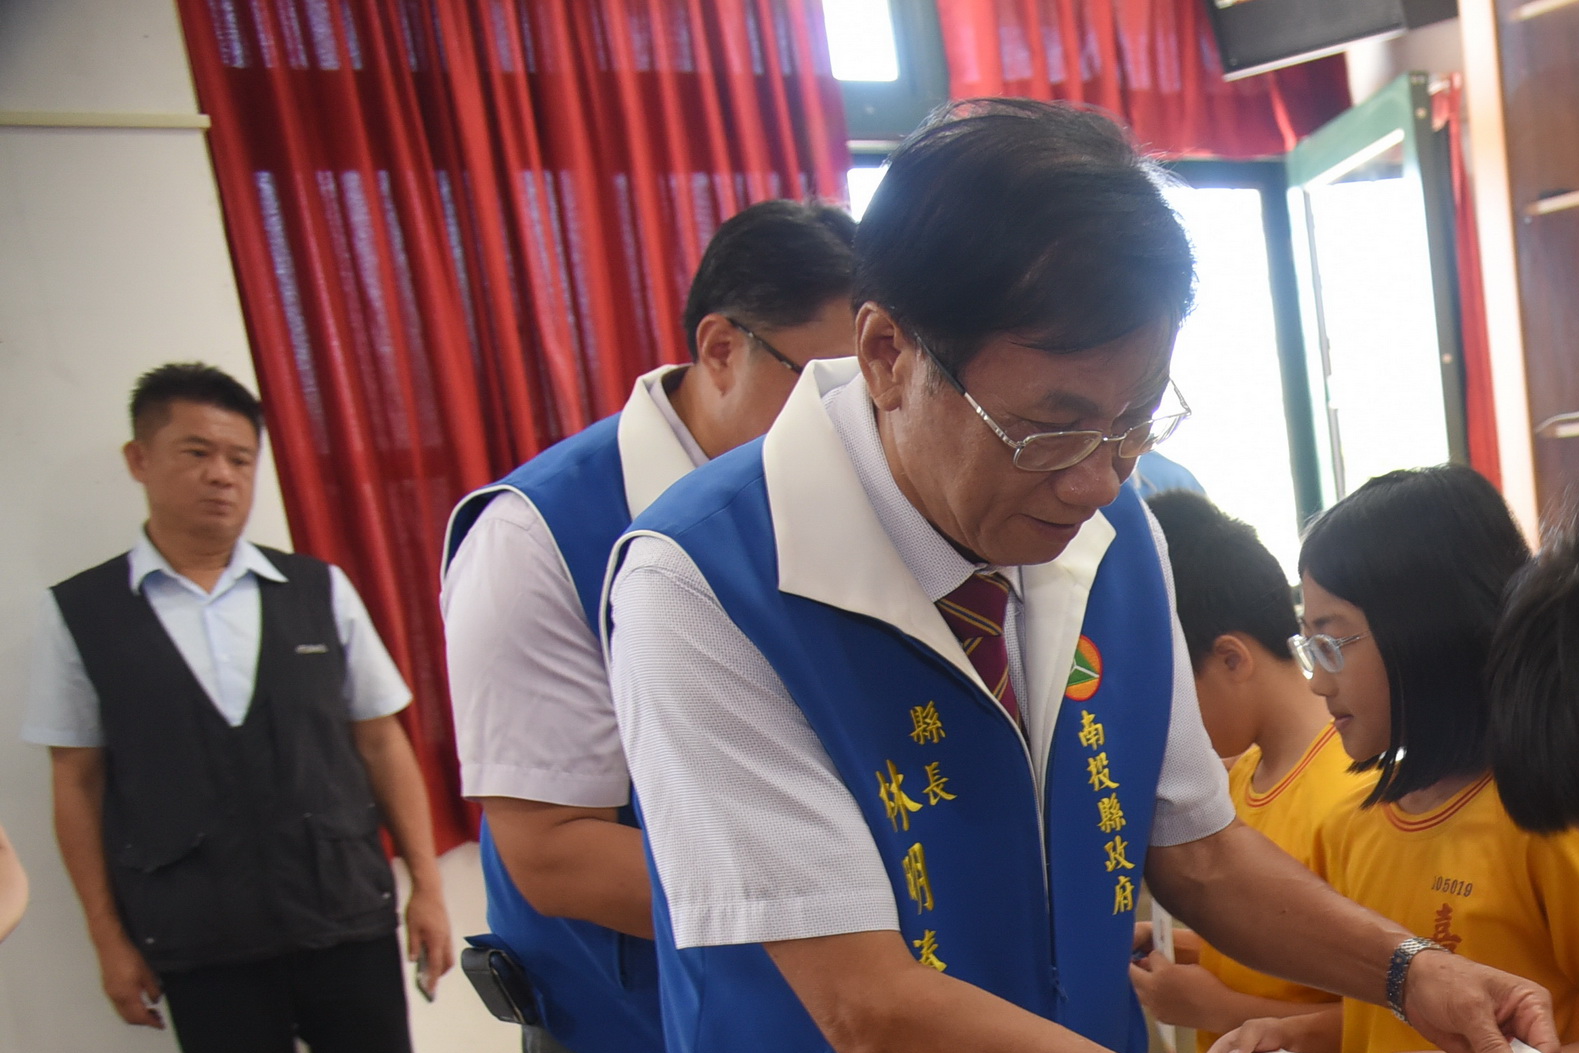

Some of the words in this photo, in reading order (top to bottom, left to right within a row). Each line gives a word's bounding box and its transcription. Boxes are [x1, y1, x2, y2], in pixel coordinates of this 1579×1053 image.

[909, 700, 958, 806] 縣長
[1078, 709, 1136, 916] 南投縣政府
